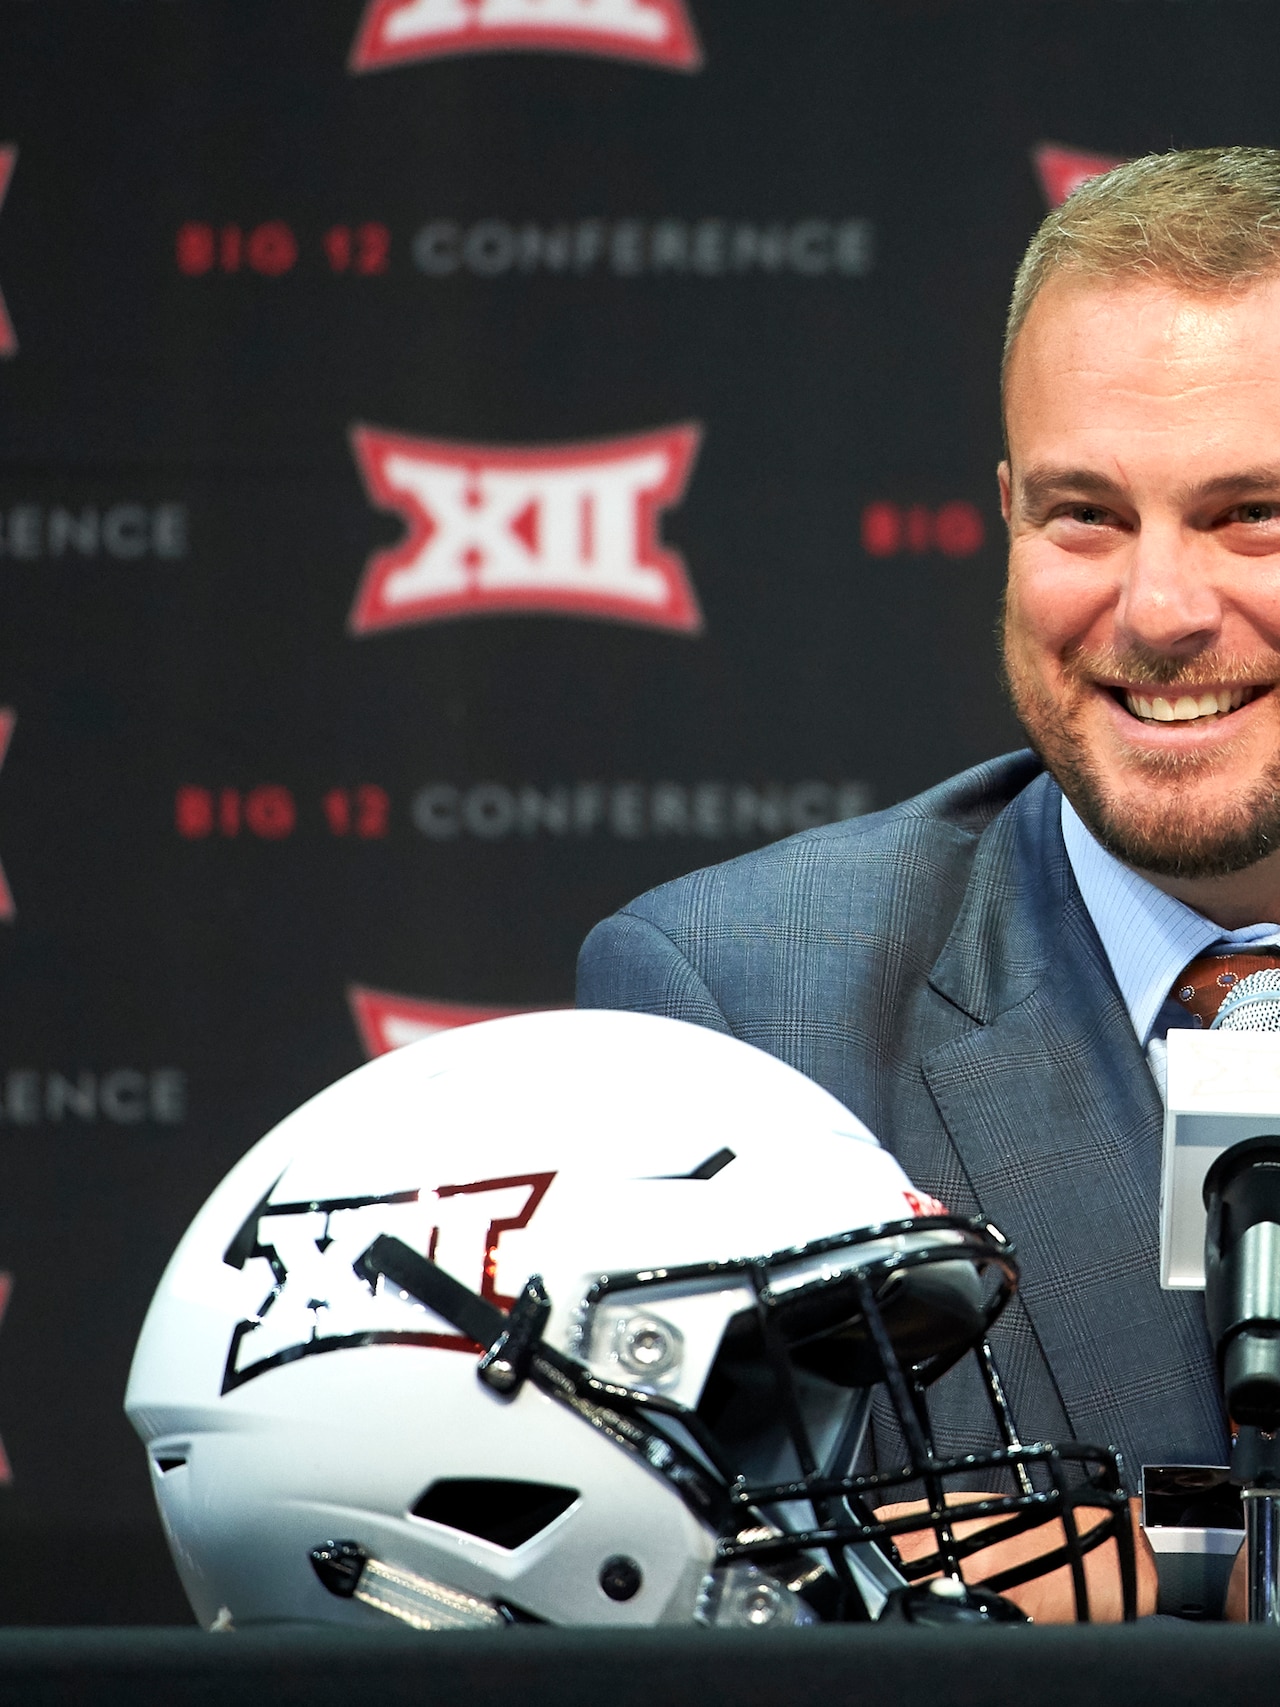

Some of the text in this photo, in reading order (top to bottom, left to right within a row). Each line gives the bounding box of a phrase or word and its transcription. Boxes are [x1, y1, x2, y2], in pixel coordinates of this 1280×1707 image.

[176, 219, 874, 276] BIG 12 CONFERENCE
[861, 502, 985, 556] BIG
[175, 785, 297, 838] BIG
[323, 785, 391, 838] 12
